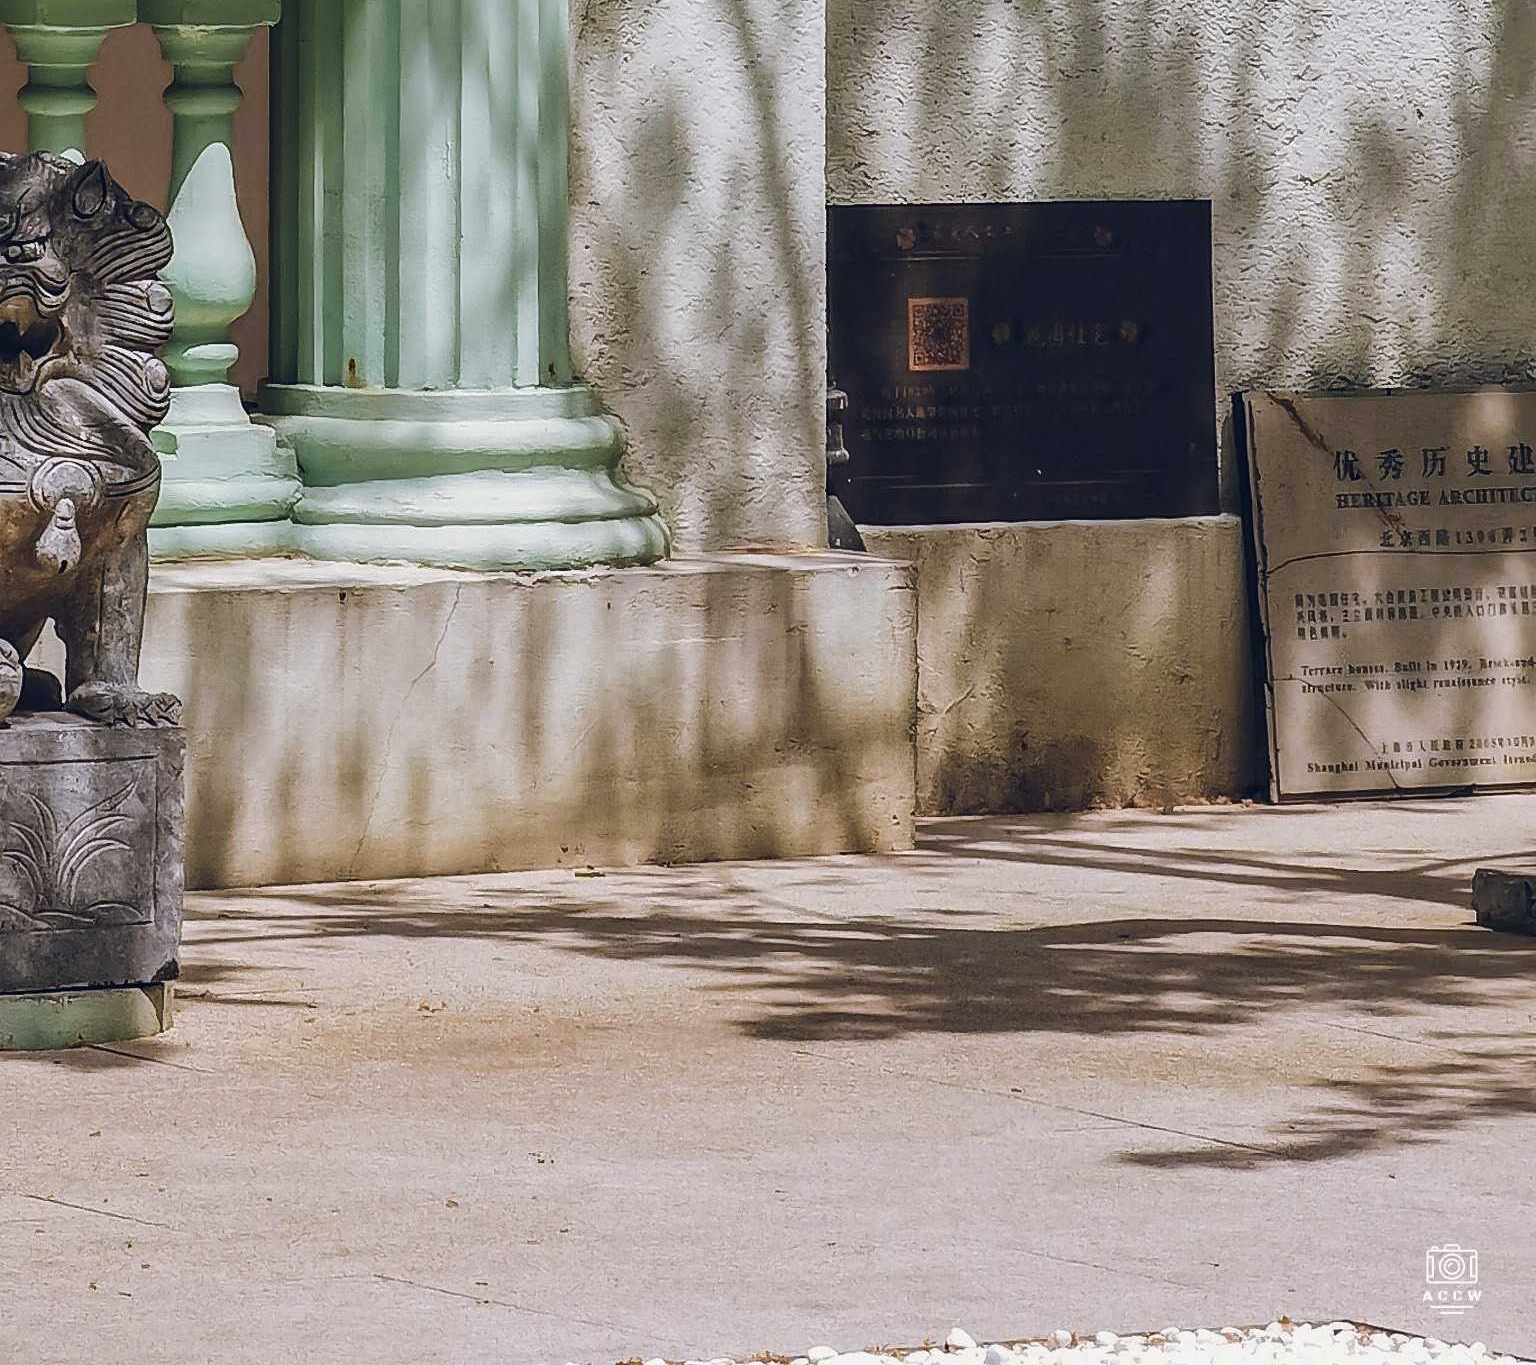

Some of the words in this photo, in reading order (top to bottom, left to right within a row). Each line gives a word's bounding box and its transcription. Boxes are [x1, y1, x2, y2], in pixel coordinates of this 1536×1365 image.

[1333, 442, 1536, 482] 优秀历史建
[1336, 491, 1431, 509] HERITAGE
[1307, 762, 1358, 774] Shanghai
[1365, 758, 1422, 771] Municipal
[1428, 755, 1496, 767] Government
